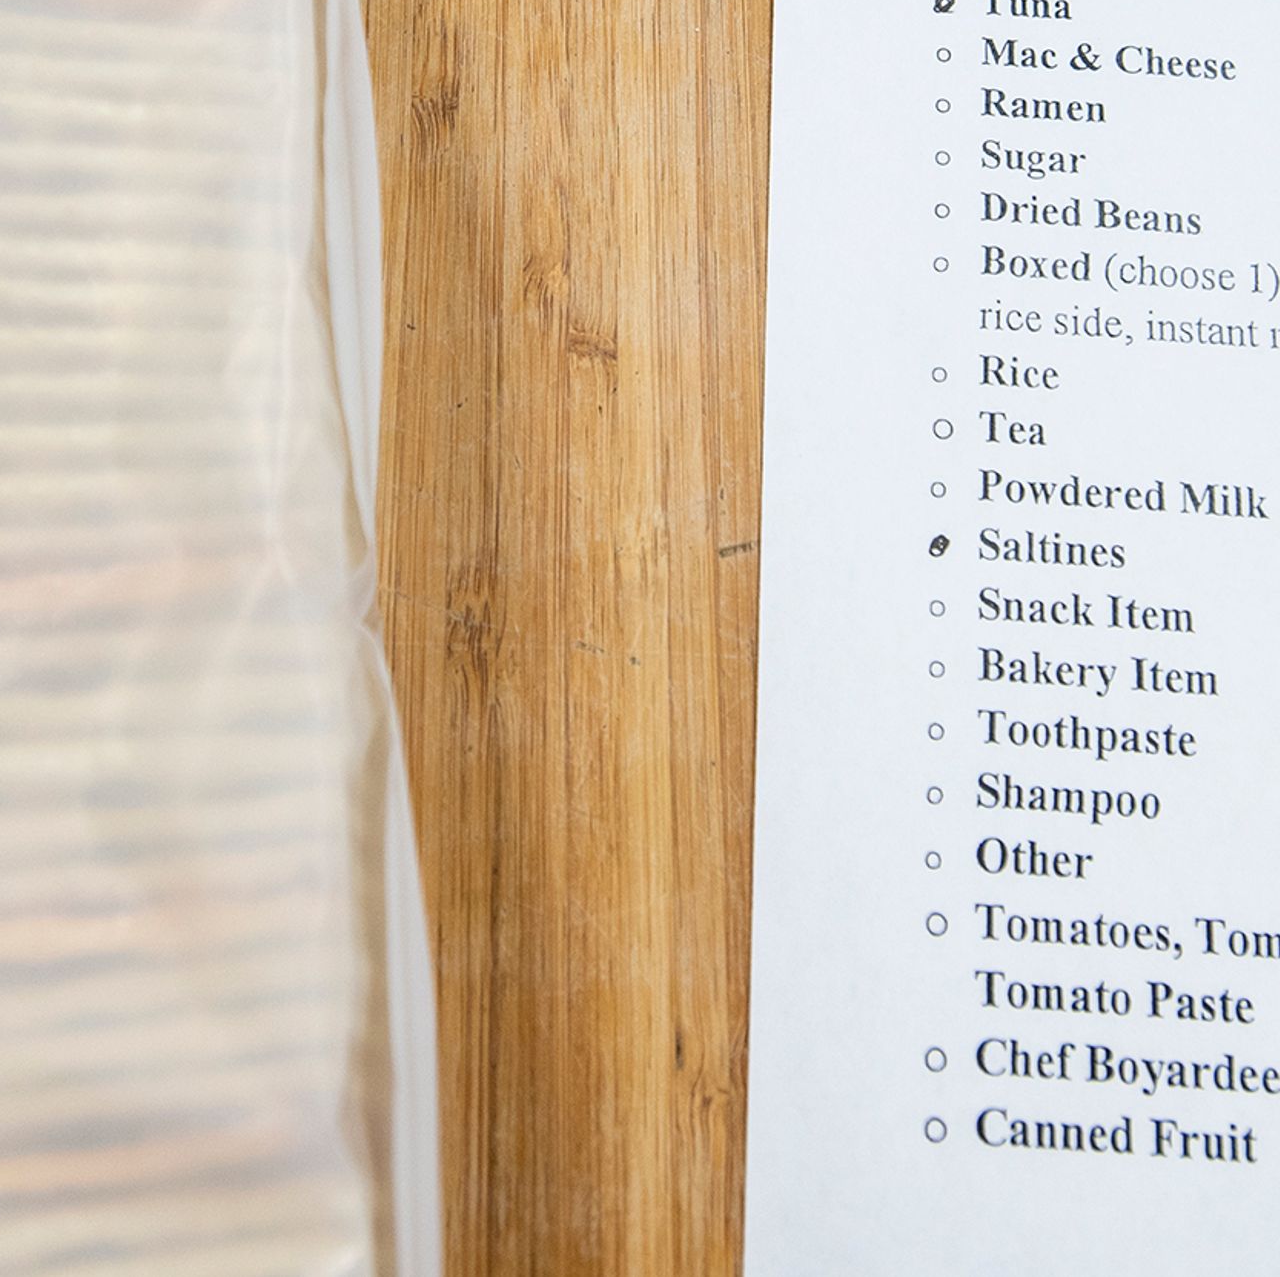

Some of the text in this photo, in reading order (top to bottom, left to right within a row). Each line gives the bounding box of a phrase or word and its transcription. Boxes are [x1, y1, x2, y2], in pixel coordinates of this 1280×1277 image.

[981, 245, 1090, 281] Boxed
[1105, 253, 1235, 291] (choose
[979, 528, 1125, 568] Saltines
[978, 709, 1196, 761] Toothpaste
[976, 1038, 1076, 1080] Chef
[1086, 1044, 1280, 1096] Boyardee
